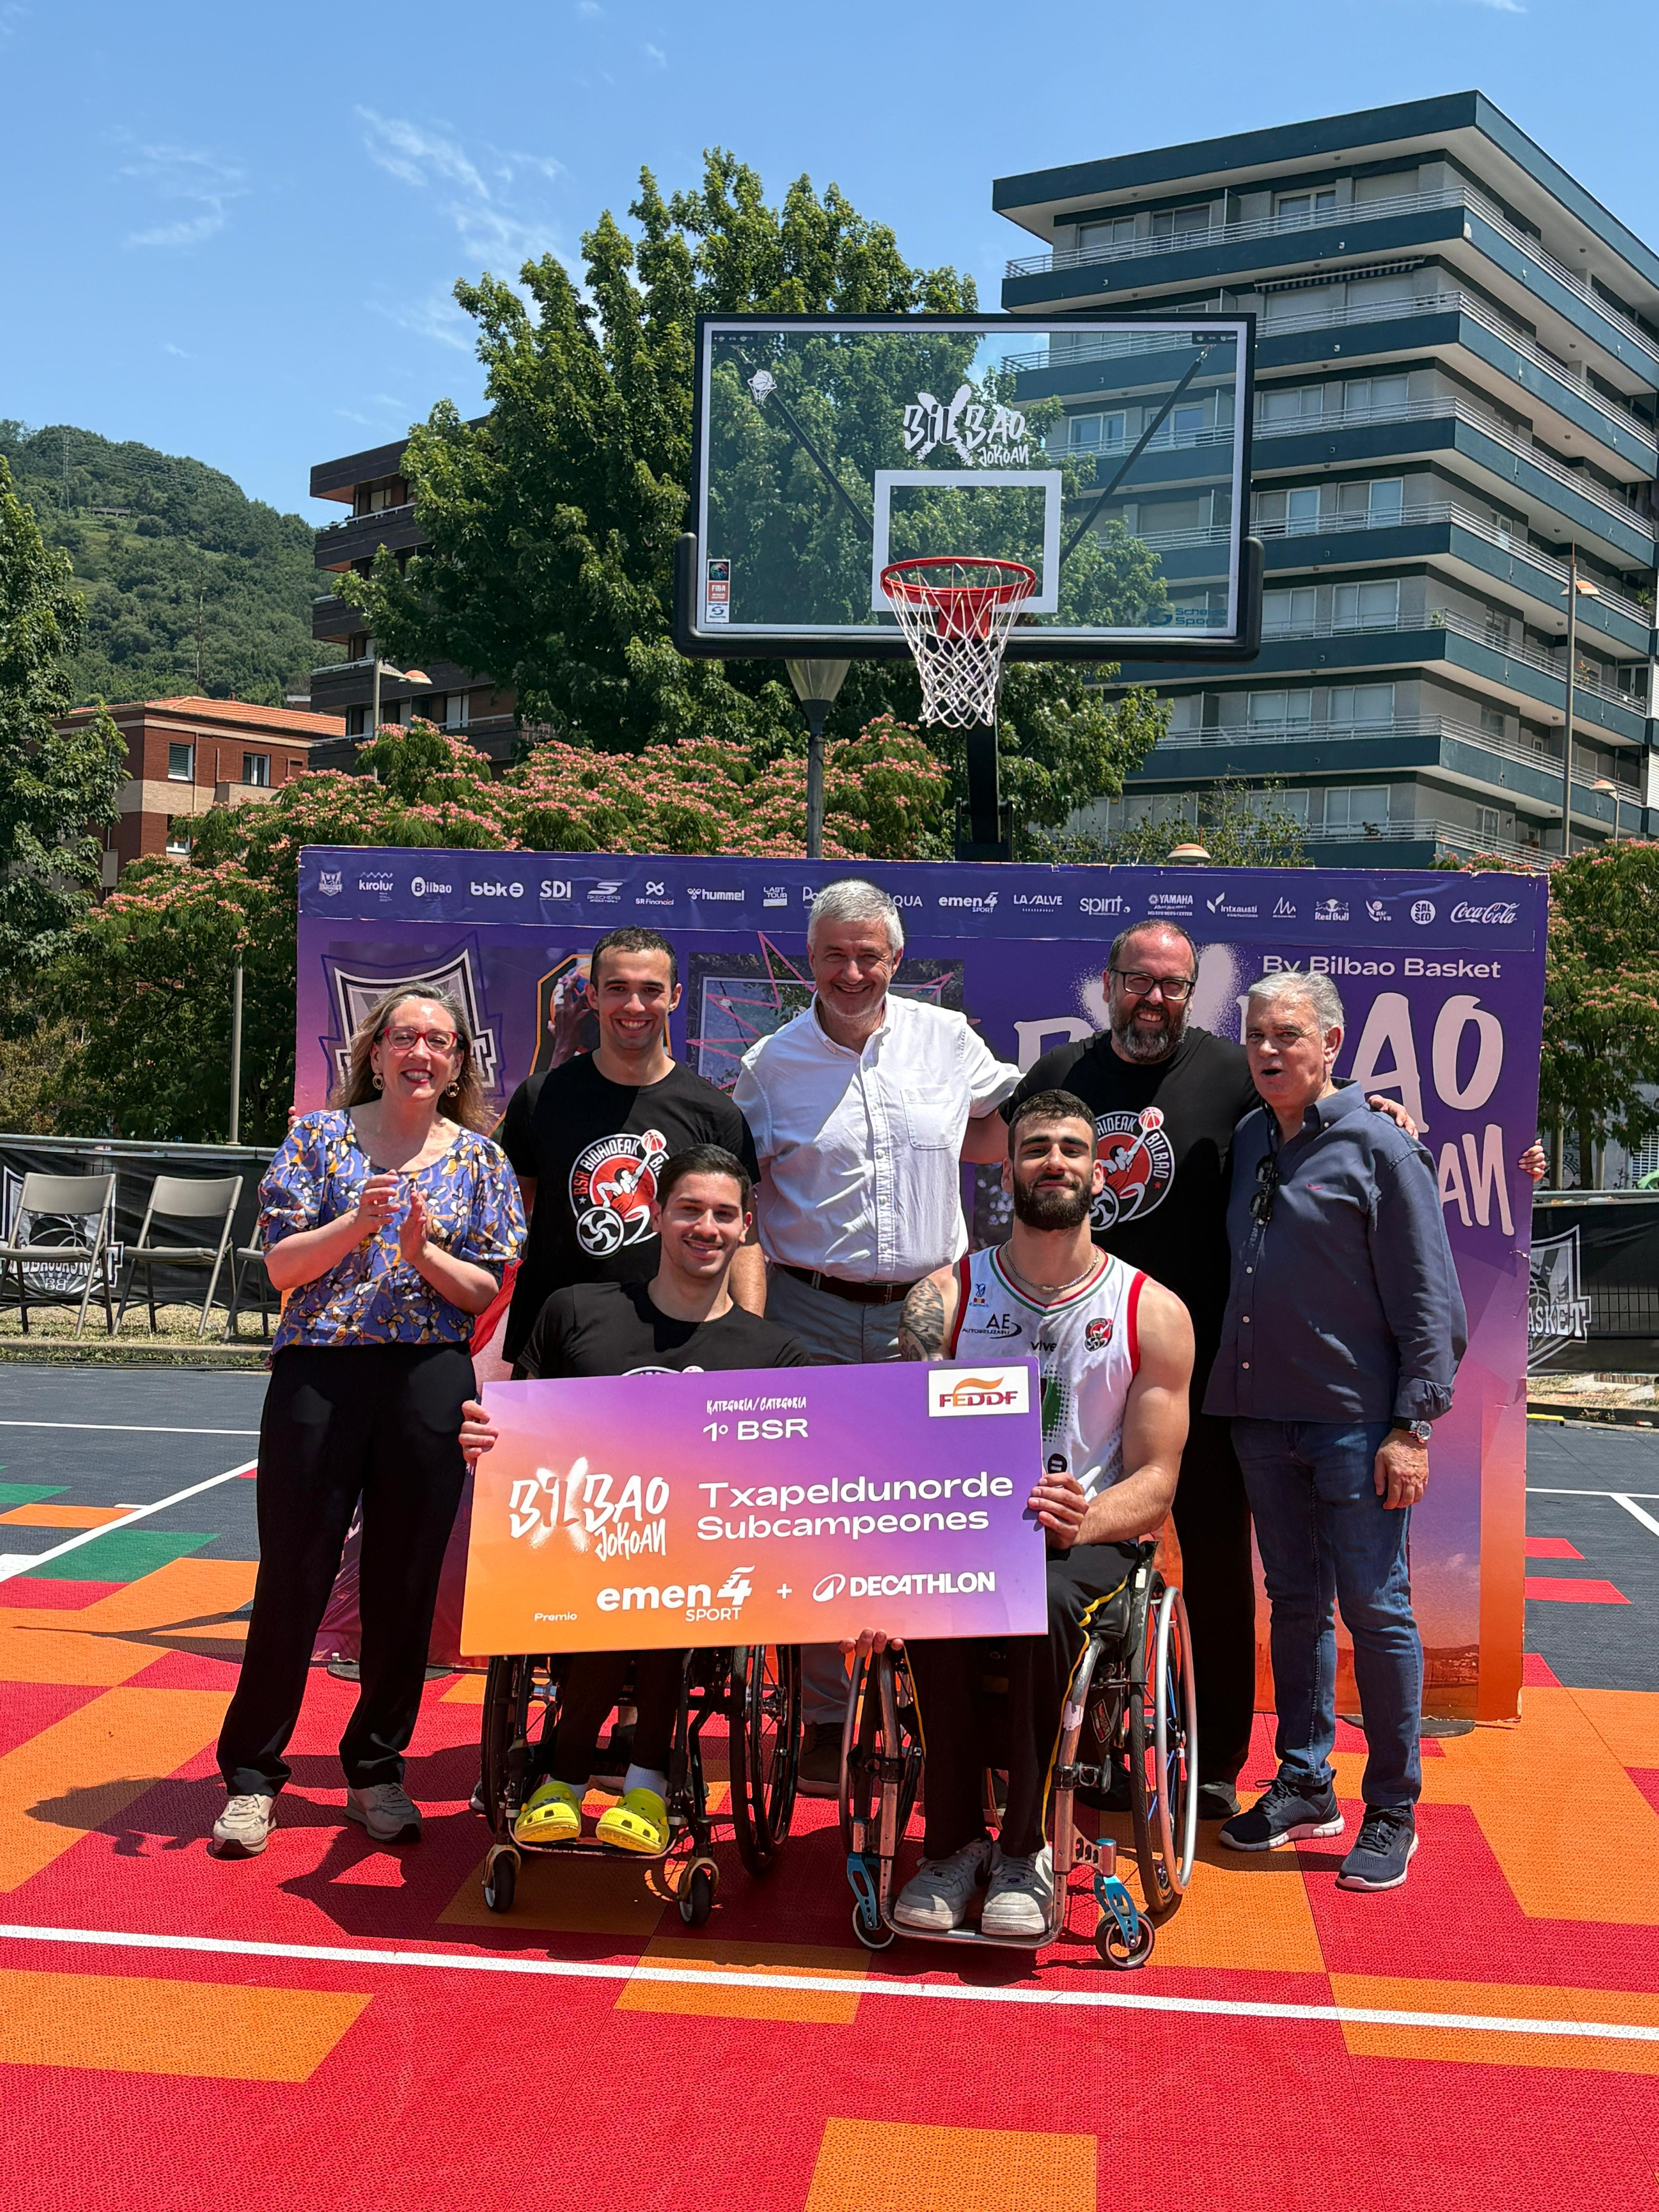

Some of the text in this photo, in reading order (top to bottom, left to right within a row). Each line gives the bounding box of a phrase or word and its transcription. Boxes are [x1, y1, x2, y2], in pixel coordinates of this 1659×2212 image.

[412, 877, 452, 896] Bilbao
[540, 880, 571, 898] SDI
[702, 889, 744, 901] hummel
[1160, 894, 1193, 905] YAMAHA
[1315, 912, 1349, 921] Red Bull
[1309, 956, 1395, 976] Bilbao
[1404, 958, 1501, 979] Basket
[1145, 1132, 1170, 1179] BILBAO
[939, 1391, 1018, 1408] FEDDF
[737, 1418, 808, 1440] BSR
[698, 1471, 1013, 1512] Txapeldunorde
[696, 1511, 989, 1540] Subcampeones
[850, 1571, 995, 1597] DECATHLON
[685, 1607, 742, 1622] SPORT
